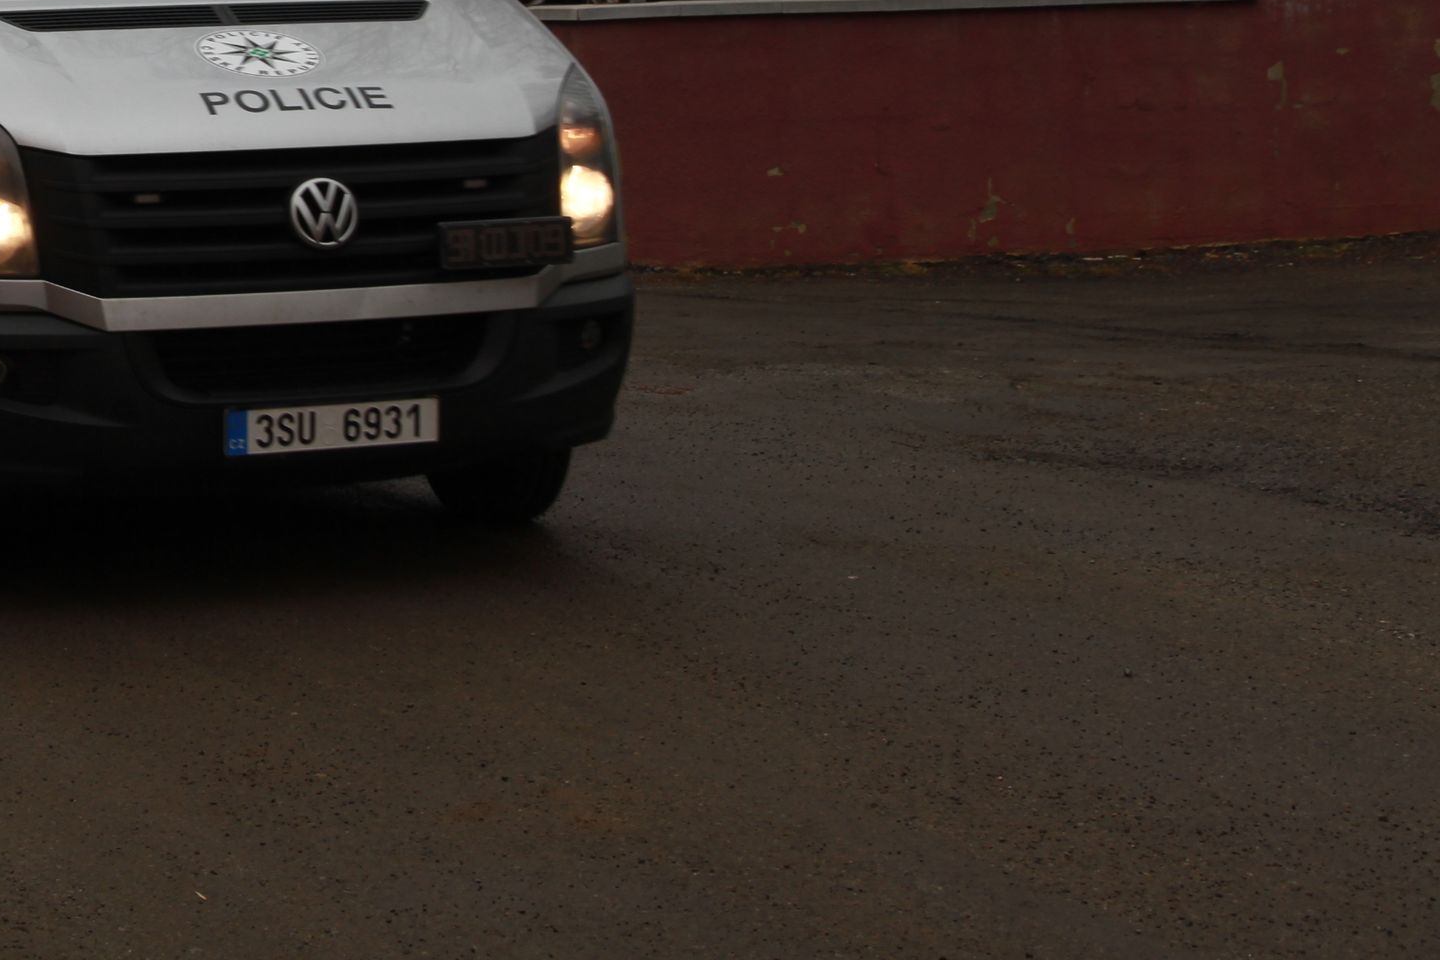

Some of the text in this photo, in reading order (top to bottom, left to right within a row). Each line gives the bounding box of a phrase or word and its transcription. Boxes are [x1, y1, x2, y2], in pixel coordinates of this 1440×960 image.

[199, 86, 394, 115] POLICIE
[255, 404, 421, 448] 3SU 6931
[229, 438, 245, 449] CZ
